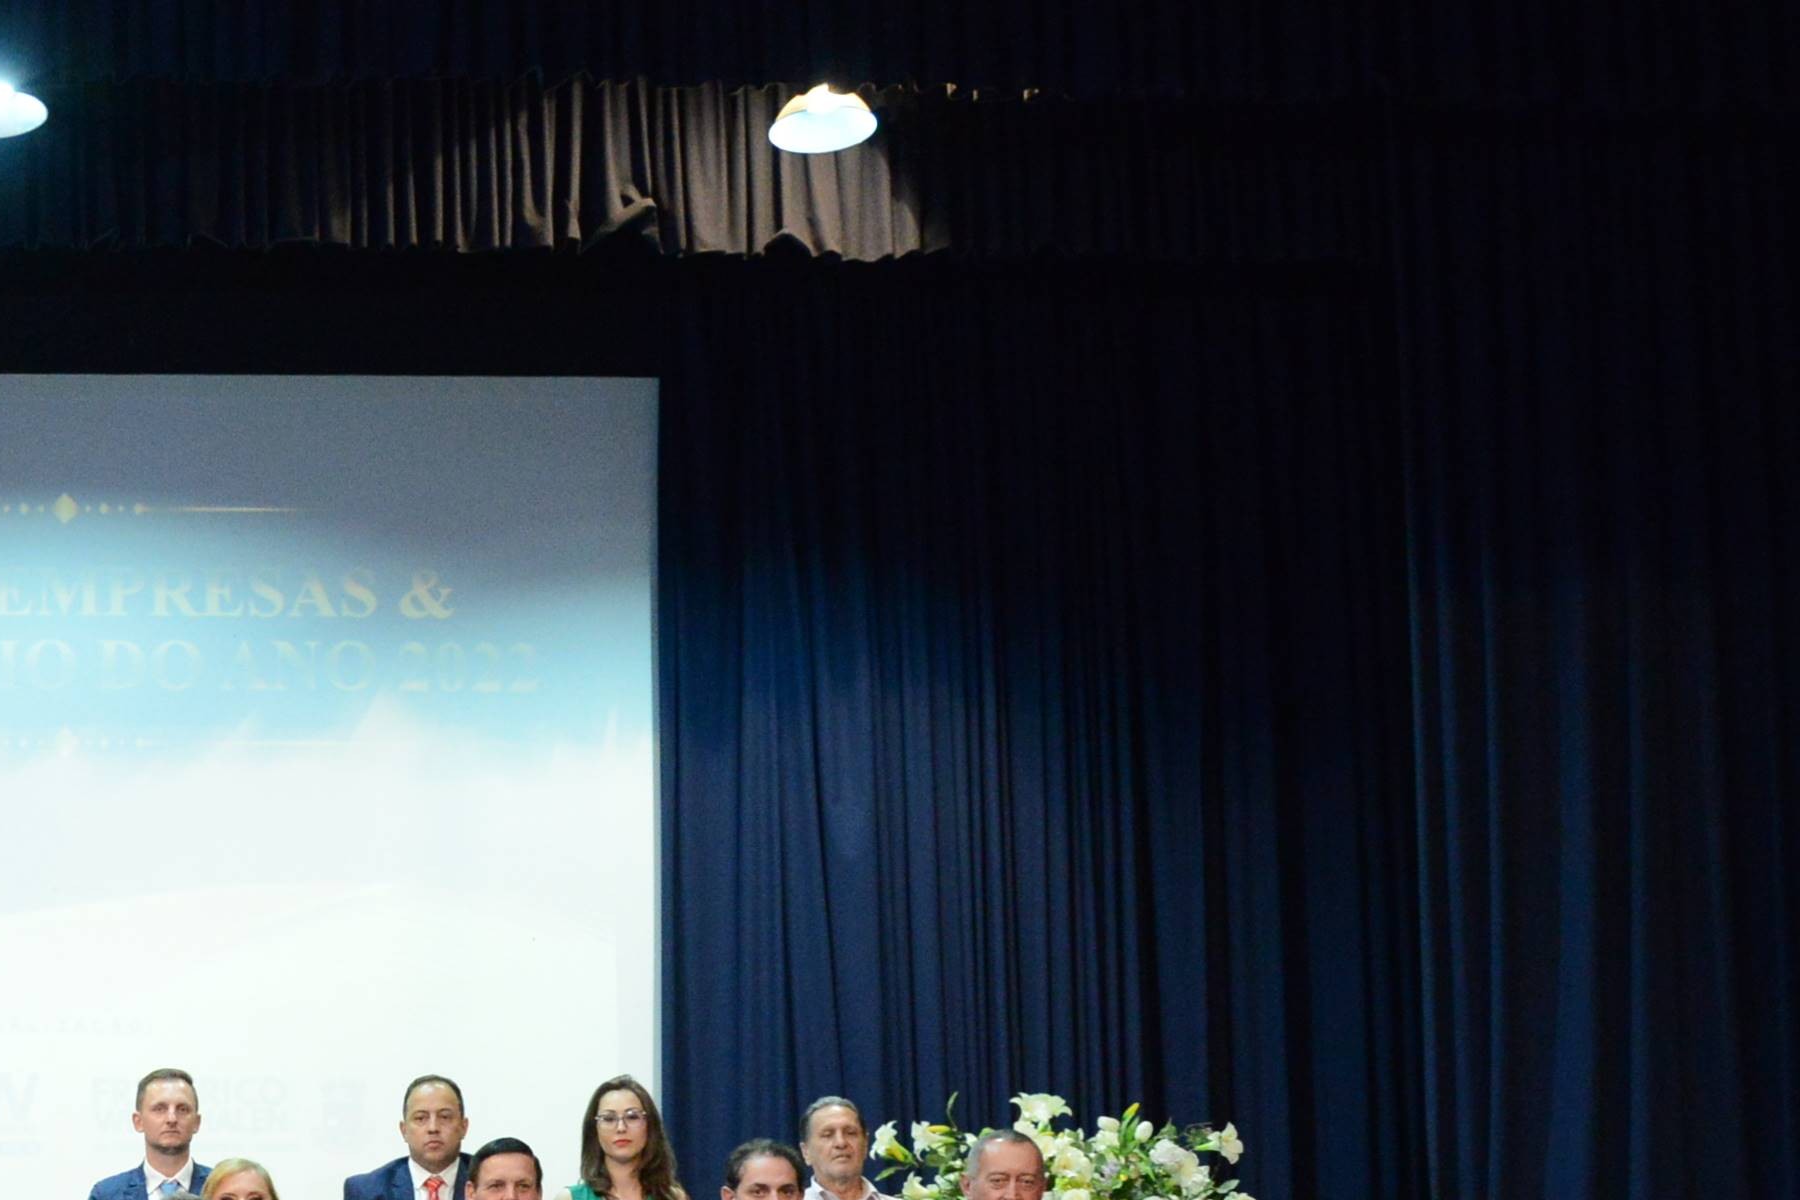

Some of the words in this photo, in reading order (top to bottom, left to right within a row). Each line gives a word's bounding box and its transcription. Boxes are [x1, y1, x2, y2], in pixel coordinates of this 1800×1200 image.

[399, 566, 456, 620] &
[96, 639, 205, 691] DO
[219, 639, 377, 691] ANO
[397, 640, 546, 693] 2022
